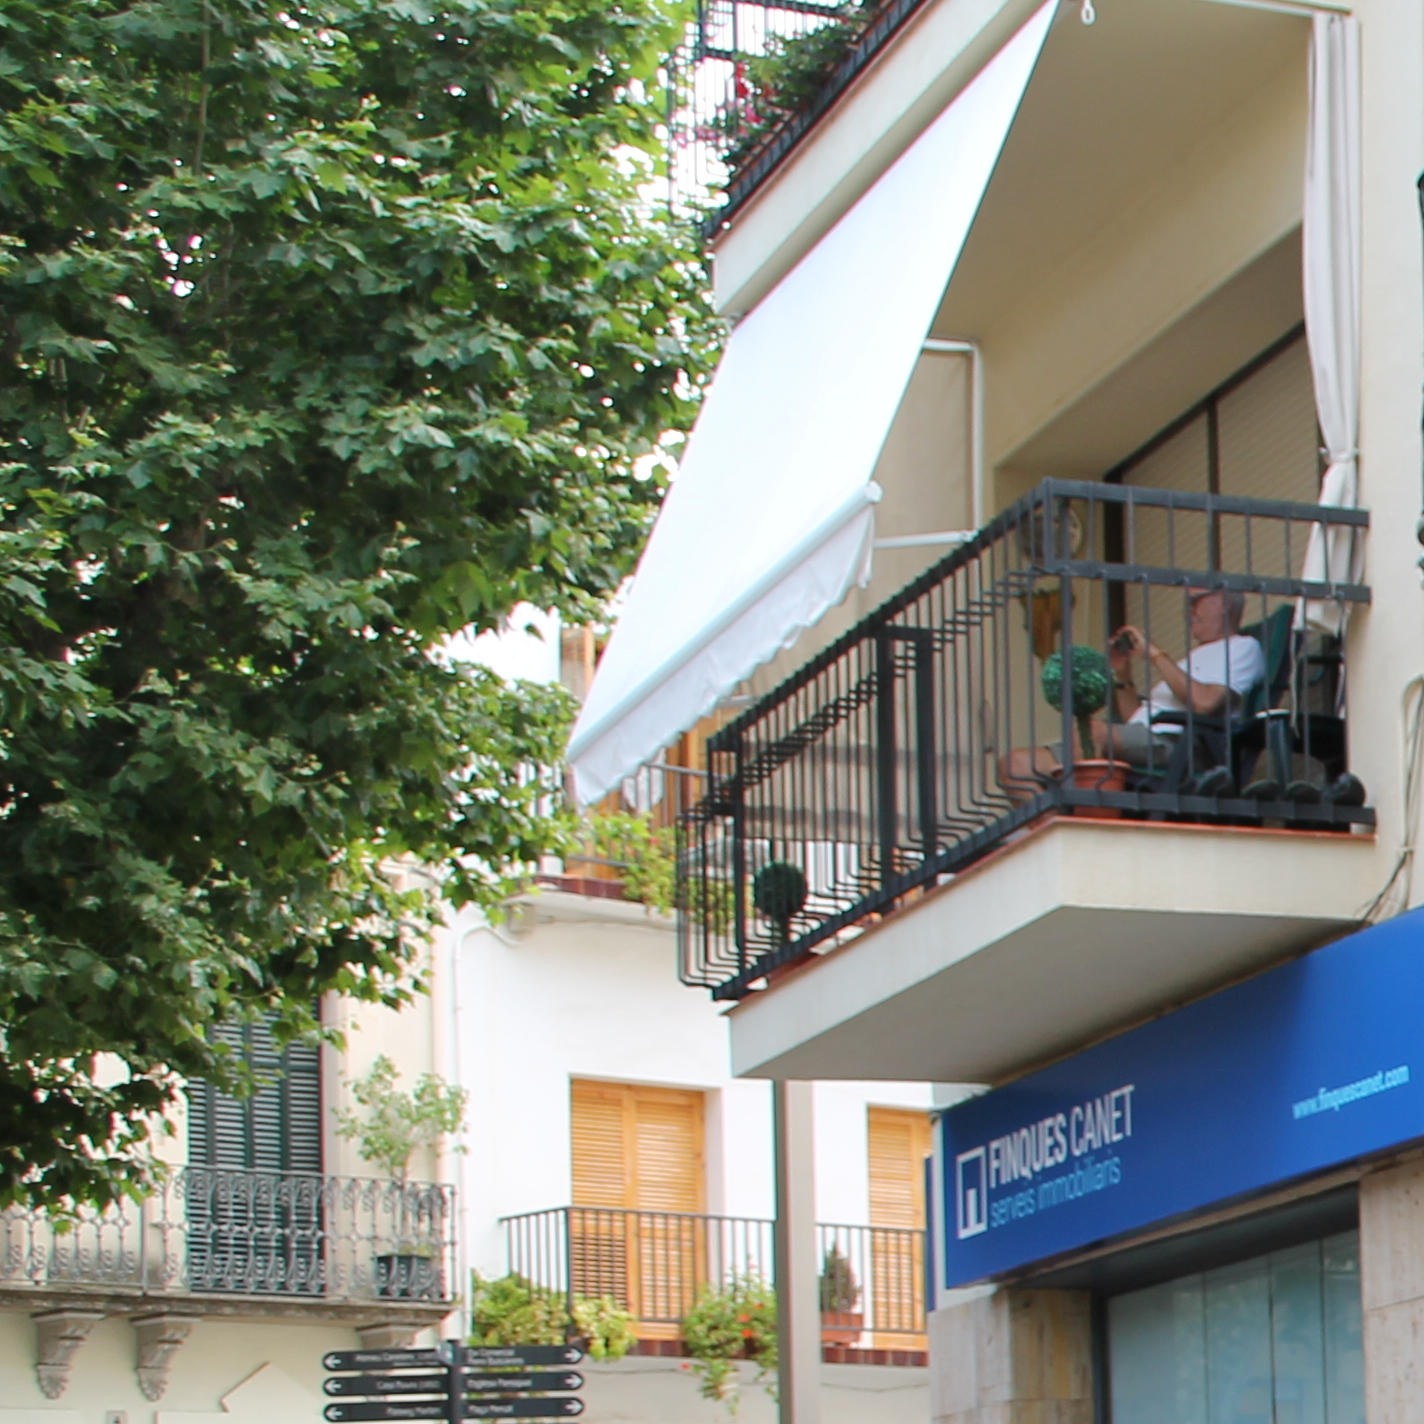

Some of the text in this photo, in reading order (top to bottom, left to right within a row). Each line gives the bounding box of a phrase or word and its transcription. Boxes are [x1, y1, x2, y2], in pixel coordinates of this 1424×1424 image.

[989, 1084, 1135, 1189] FINQUES CANET
[990, 1180, 1036, 1229] serveis
